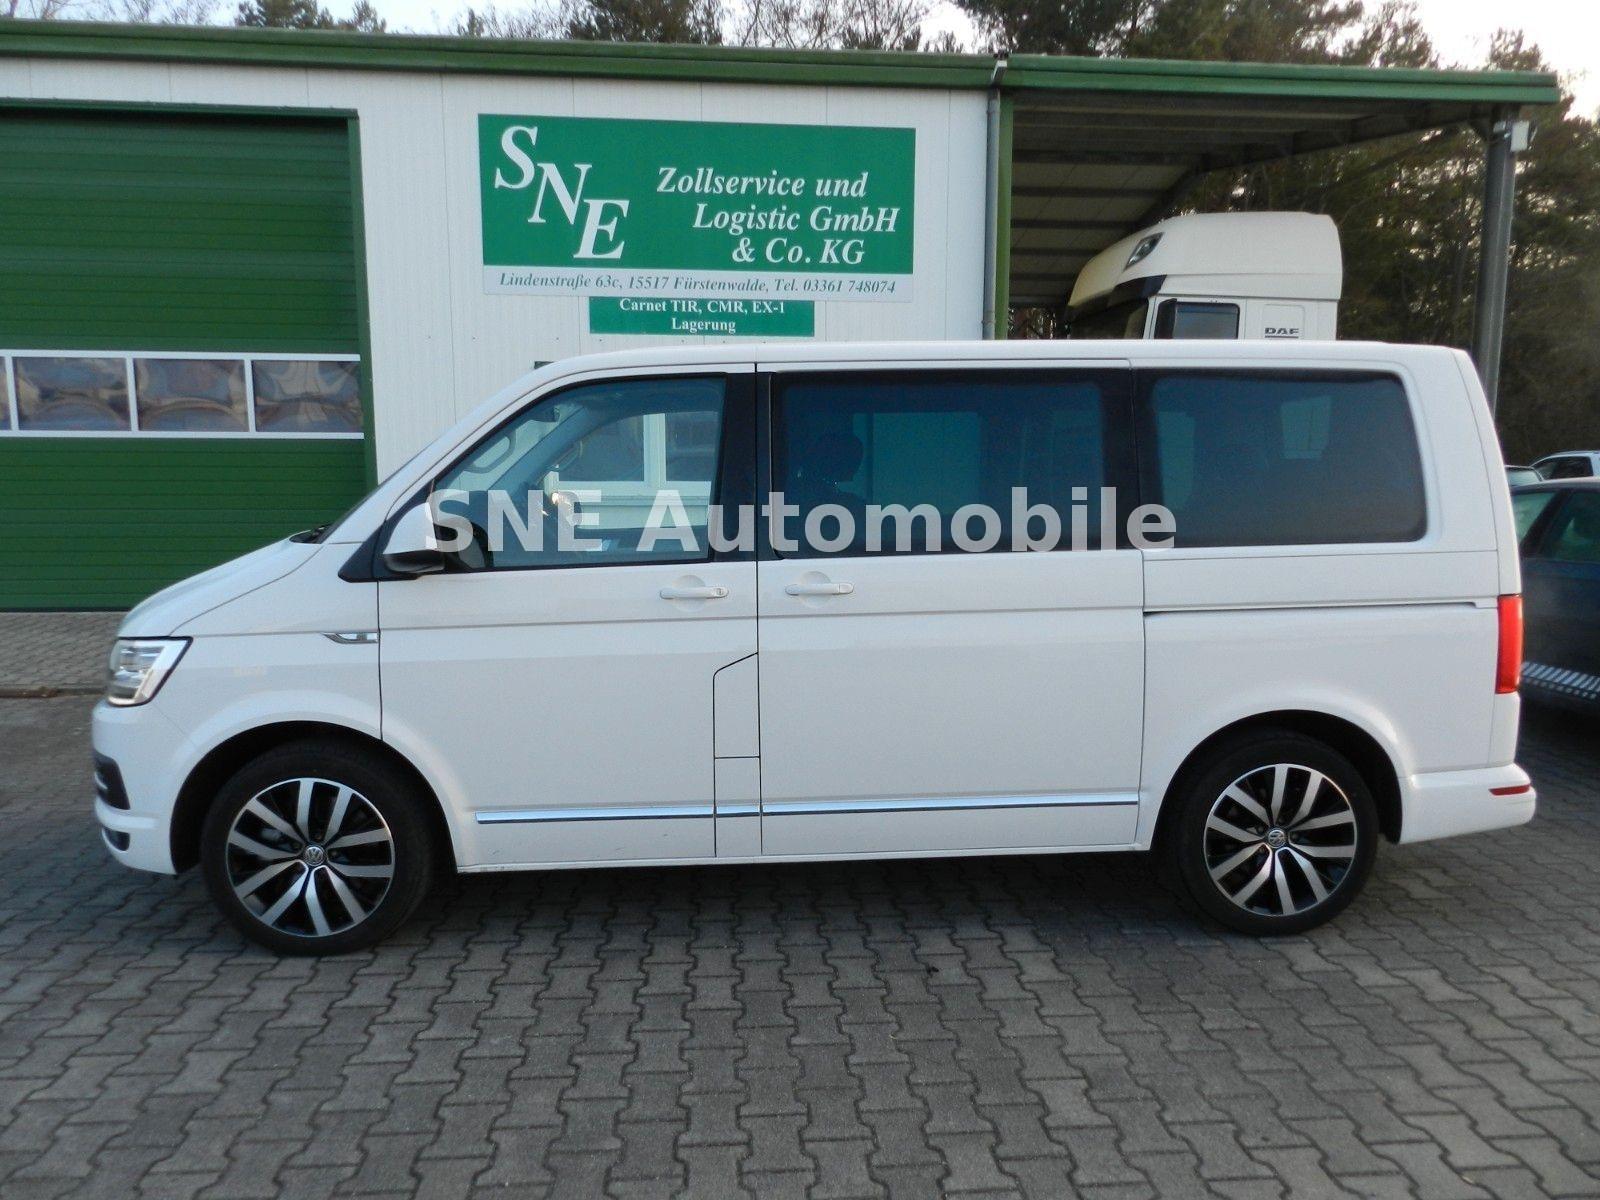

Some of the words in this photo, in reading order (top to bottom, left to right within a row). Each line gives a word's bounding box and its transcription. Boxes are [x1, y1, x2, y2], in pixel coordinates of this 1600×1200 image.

[494, 125, 629, 259] SNE
[656, 167, 805, 196] Zollservice
[815, 172, 868, 196] und
[692, 204, 799, 235] Logistic
[809, 206, 899, 232] GmbH
[731, 238, 756, 263] &
[765, 238, 811, 264] Co.
[820, 239, 865, 265] KG
[500, 273, 591, 290] Lindenstraße
[595, 275, 622, 289] 63c,
[629, 276, 669, 289] 15517
[674, 276, 769, 293] Fürstenwalde,
[775, 279, 798, 291] Tel.
[803, 279, 843, 292] 03361
[849, 280, 896, 293] 748074
[620, 299, 667, 312] Carnet
[672, 300, 702, 314] TIR,
[707, 301, 747, 314] CMR,
[752, 302, 784, 313] EX-1
[671, 317, 736, 333] Lagerung
[1264, 327, 1299, 335] DAF
